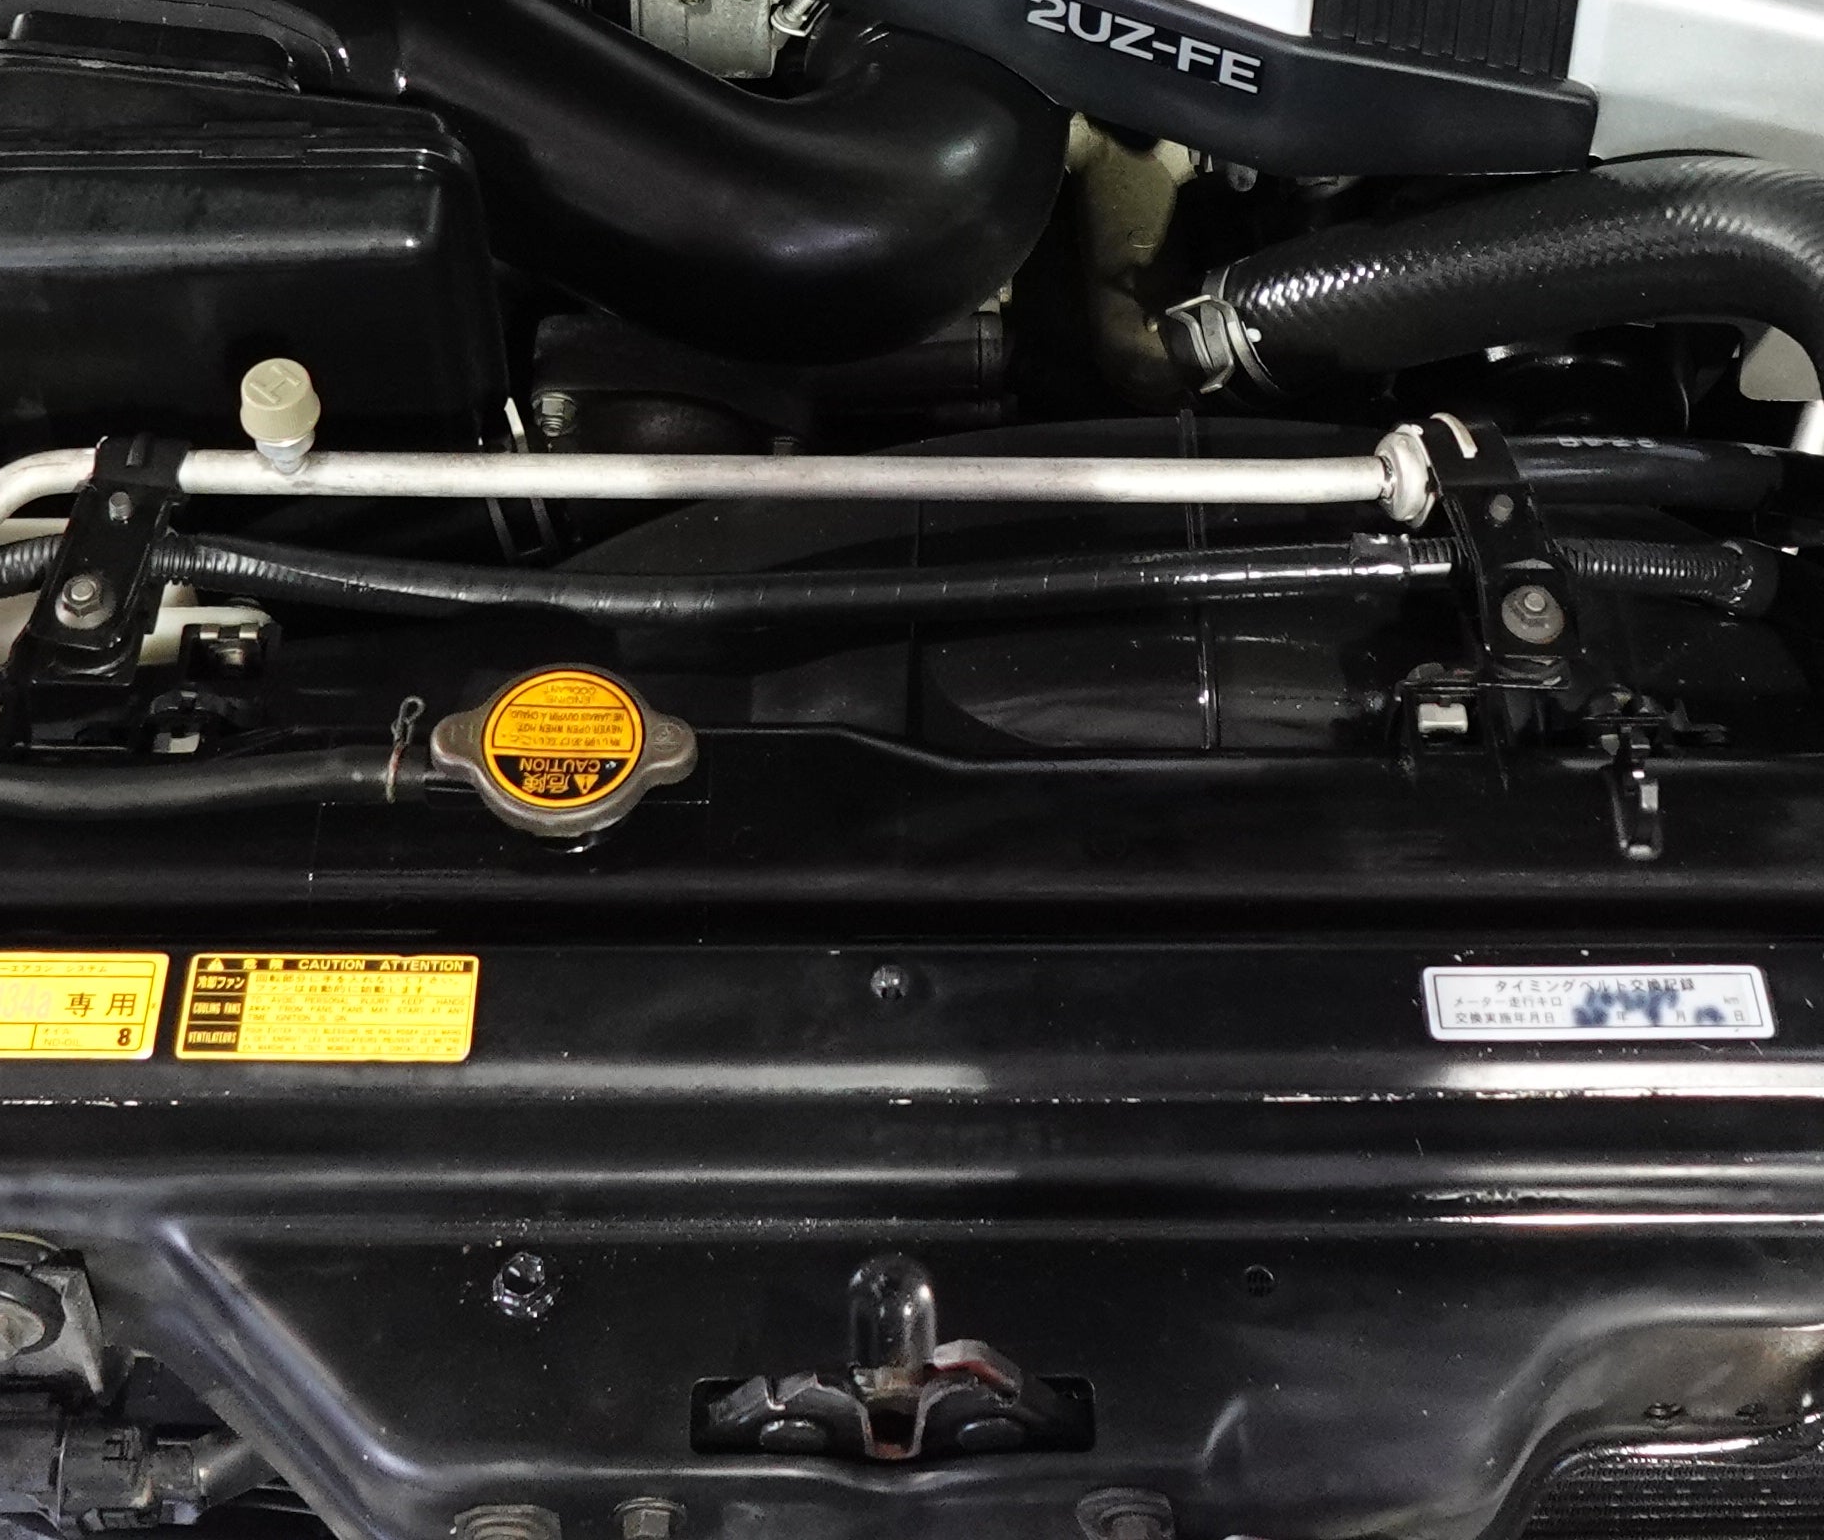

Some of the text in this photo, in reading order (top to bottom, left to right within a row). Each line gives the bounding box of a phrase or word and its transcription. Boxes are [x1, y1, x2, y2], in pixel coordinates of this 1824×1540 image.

[545, 695, 591, 704] ENGINE
[539, 724, 563, 733] WHEN
[567, 725, 591, 733] OPEN
[593, 725, 623, 733] NEVER
[519, 758, 601, 772] CAUTION
[522, 772, 570, 793] 危険
[66, 964, 107, 972] システム
[298, 959, 365, 970] CAUTION
[379, 960, 464, 971] ATTENTION
[1494, 977, 1697, 993] タイミングベルト交換記録
[65, 992, 137, 1017] 専用
[1453, 994, 1564, 1009] メーター走行キロ
[193, 1002, 242, 1015] COOLING FANS
[1454, 1010, 1558, 1024] 交換実施年月日
[1734, 1010, 1745, 1023] 日
[117, 1027, 131, 1046] 8
[188, 1031, 237, 1044] VENTILATEURS
